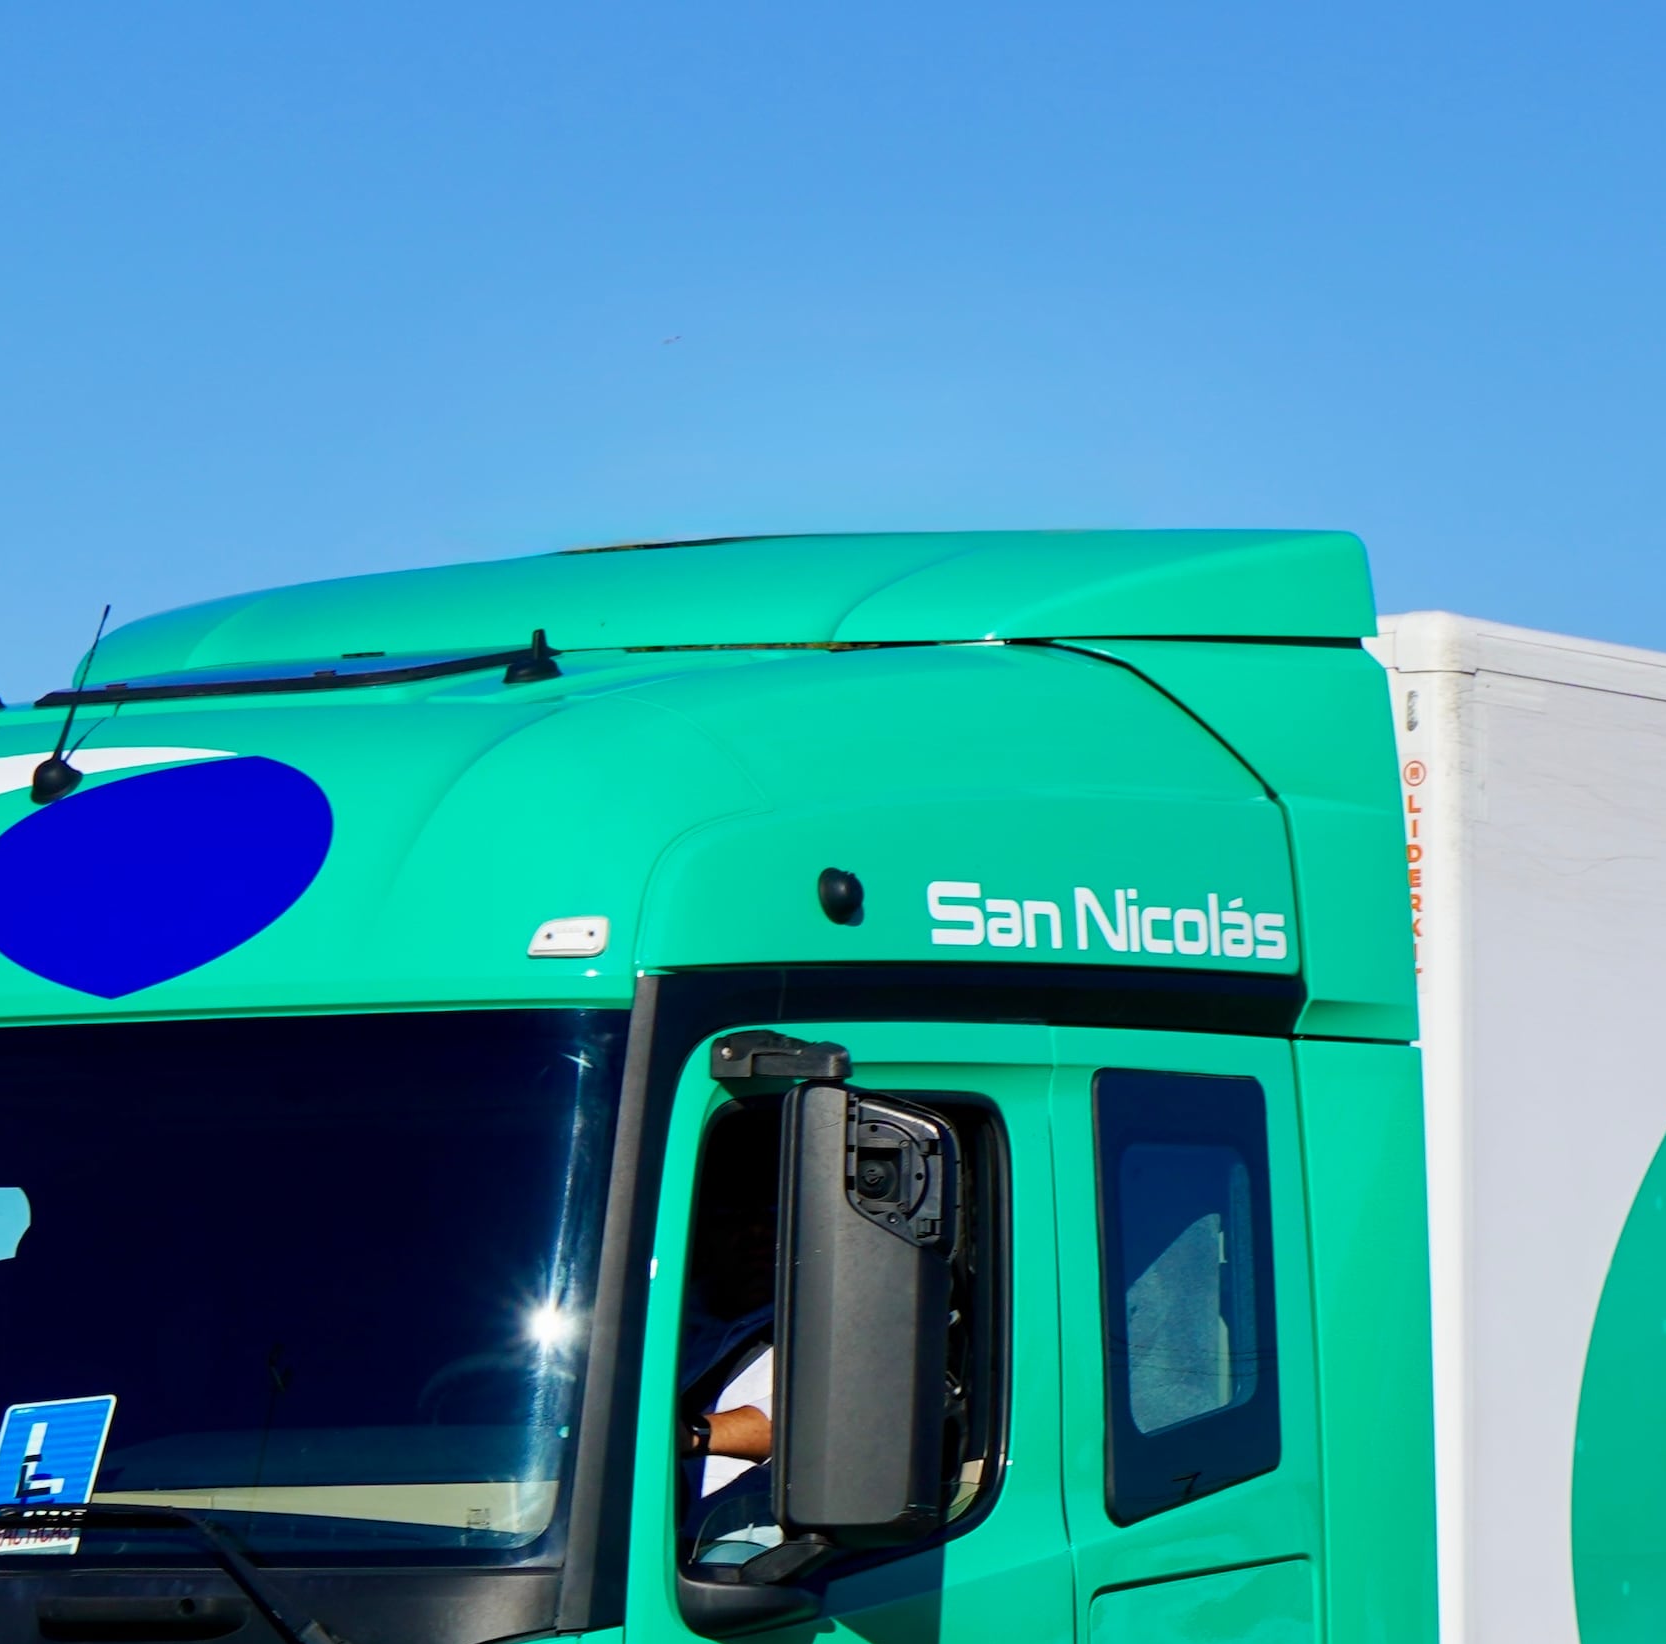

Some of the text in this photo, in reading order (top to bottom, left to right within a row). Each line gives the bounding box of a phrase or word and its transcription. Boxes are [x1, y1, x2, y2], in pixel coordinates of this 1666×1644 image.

[927, 881, 1288, 960] San Nicolás
[15, 1422, 65, 1499] L
